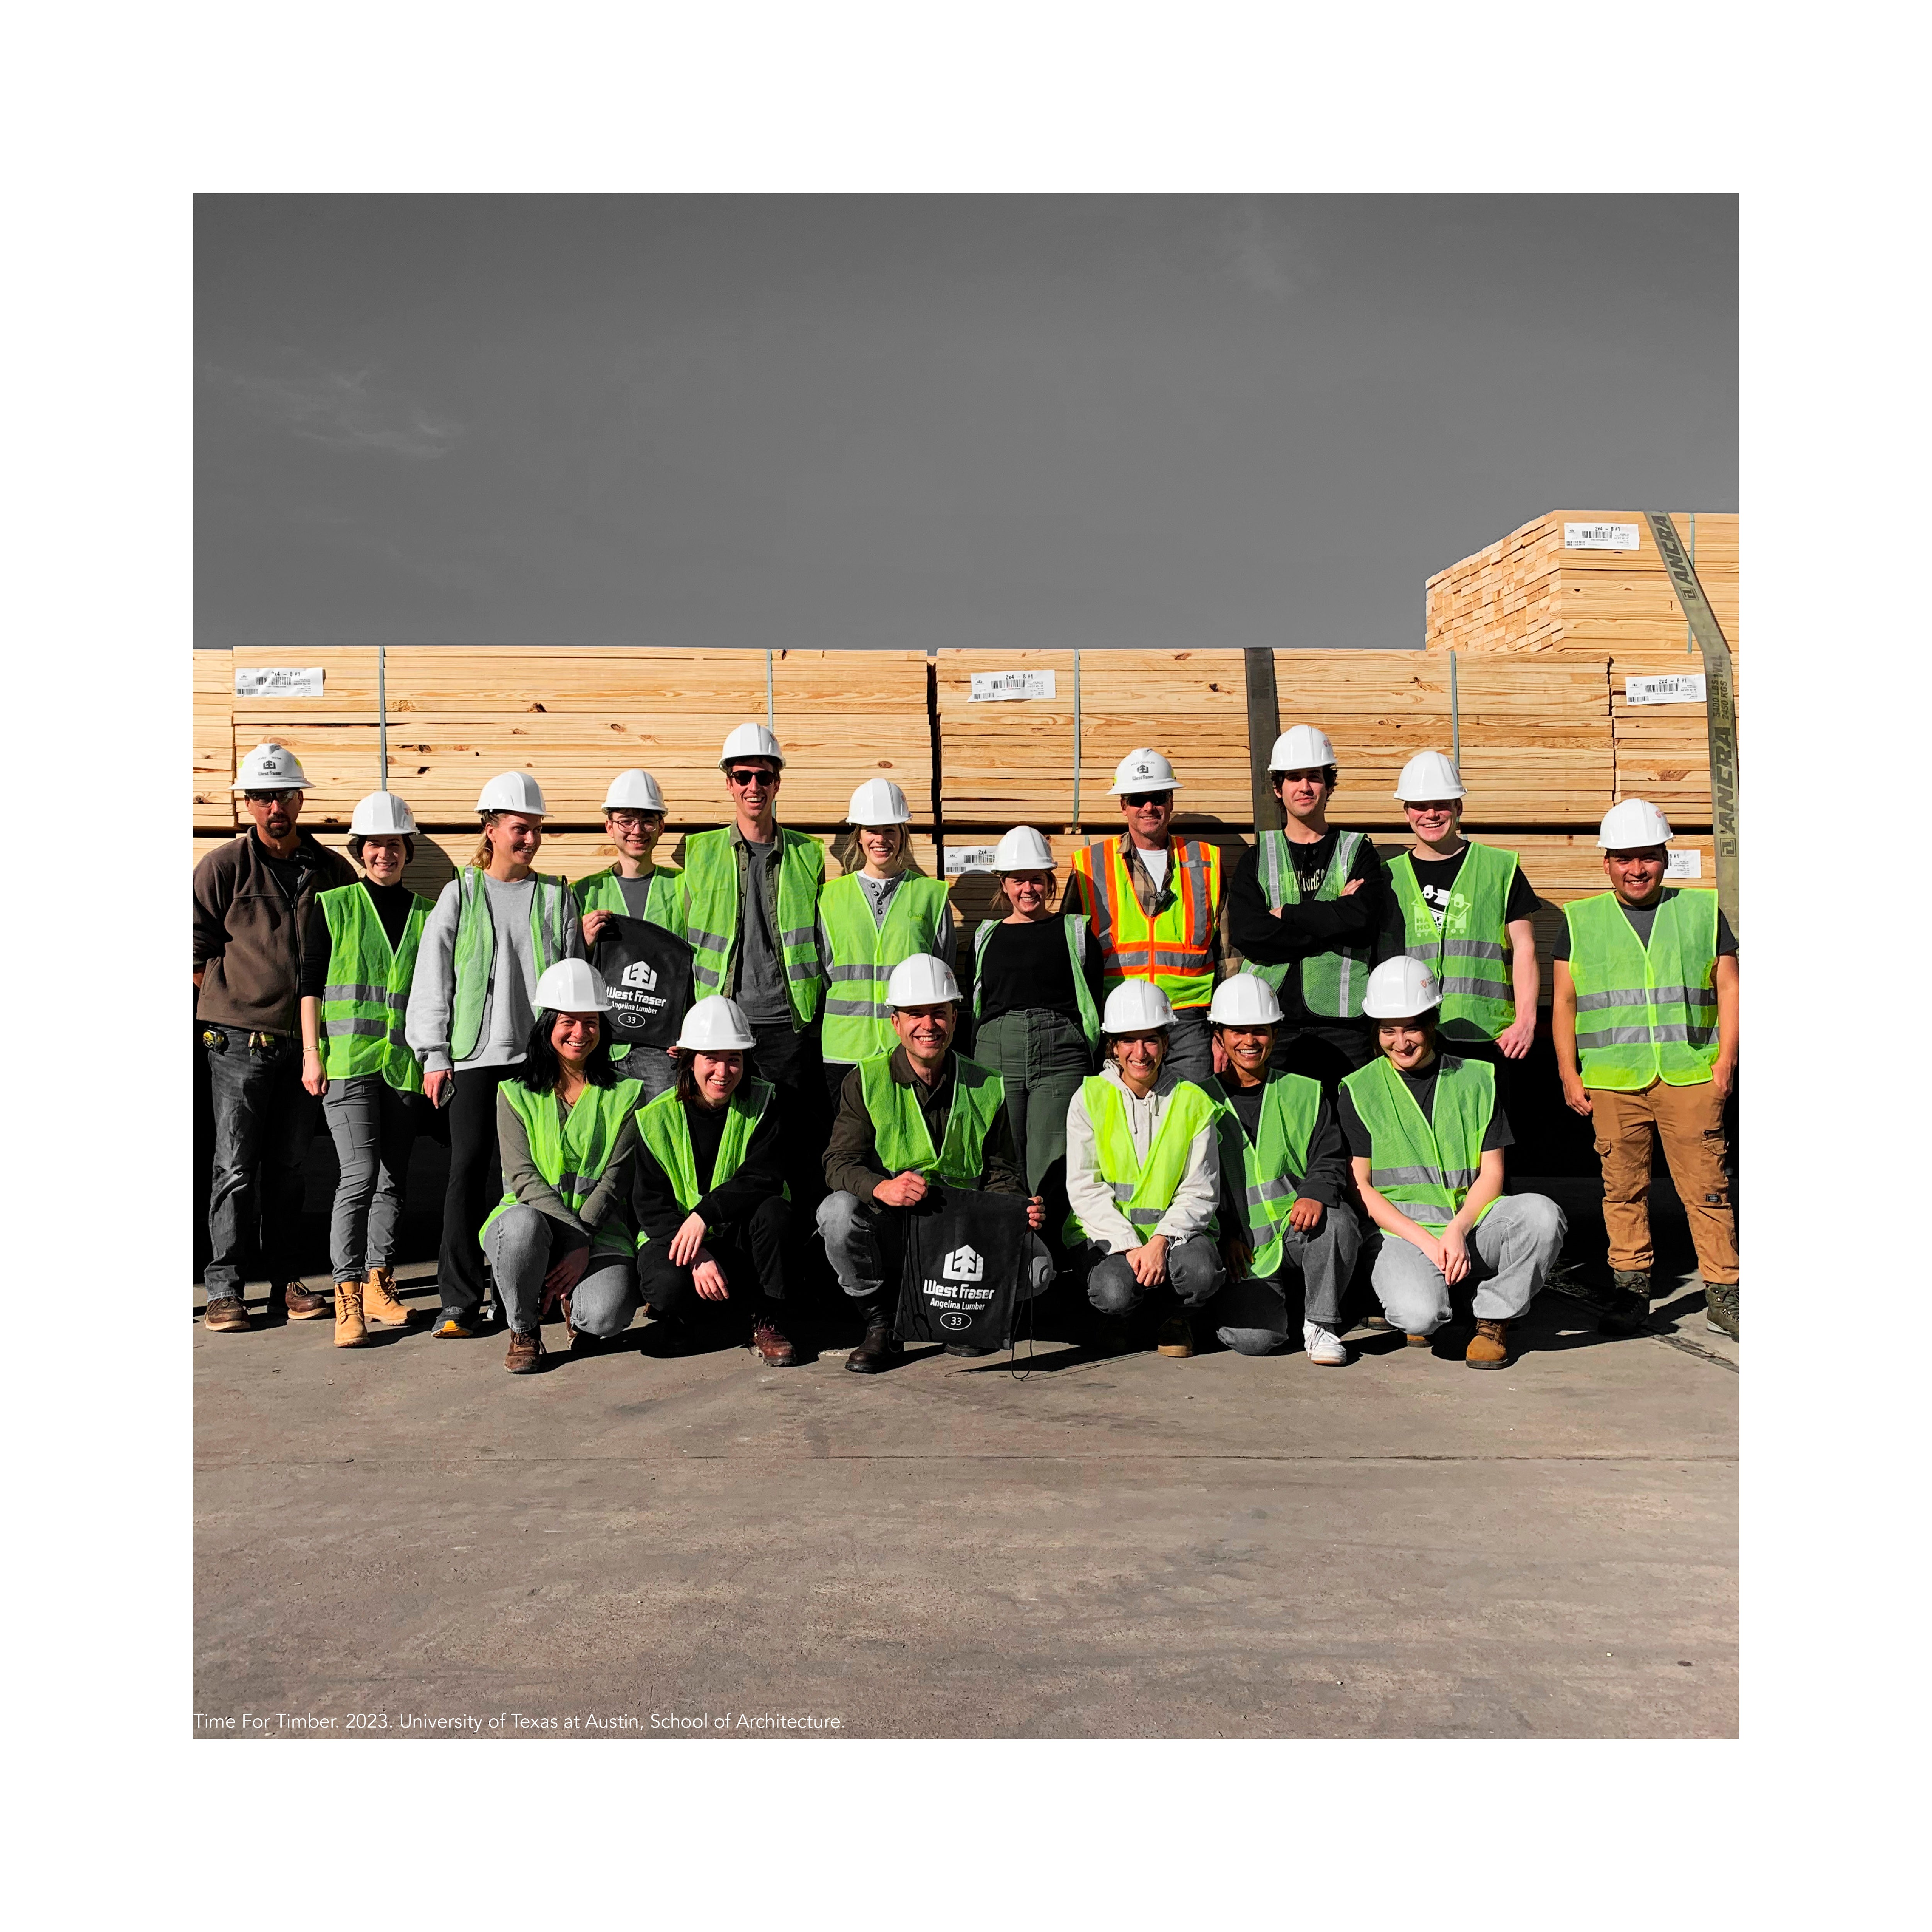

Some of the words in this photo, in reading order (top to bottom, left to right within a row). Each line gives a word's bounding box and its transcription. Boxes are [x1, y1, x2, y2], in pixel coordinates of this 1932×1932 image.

[1651, 515, 1693, 586] ANCRA
[1714, 727, 1735, 835] ANCRA
[607, 986, 634, 1001] West
[634, 990, 667, 1007] Fraser
[612, 1001, 635, 1010] Angelina
[636, 1005, 658, 1014] Lumber
[923, 1279, 958, 1298] West
[959, 1283, 995, 1299] Fraser
[930, 1298, 960, 1309] Angelina
[961, 1302, 985, 1310] Lumber
[951, 1317, 962, 1325] 33
